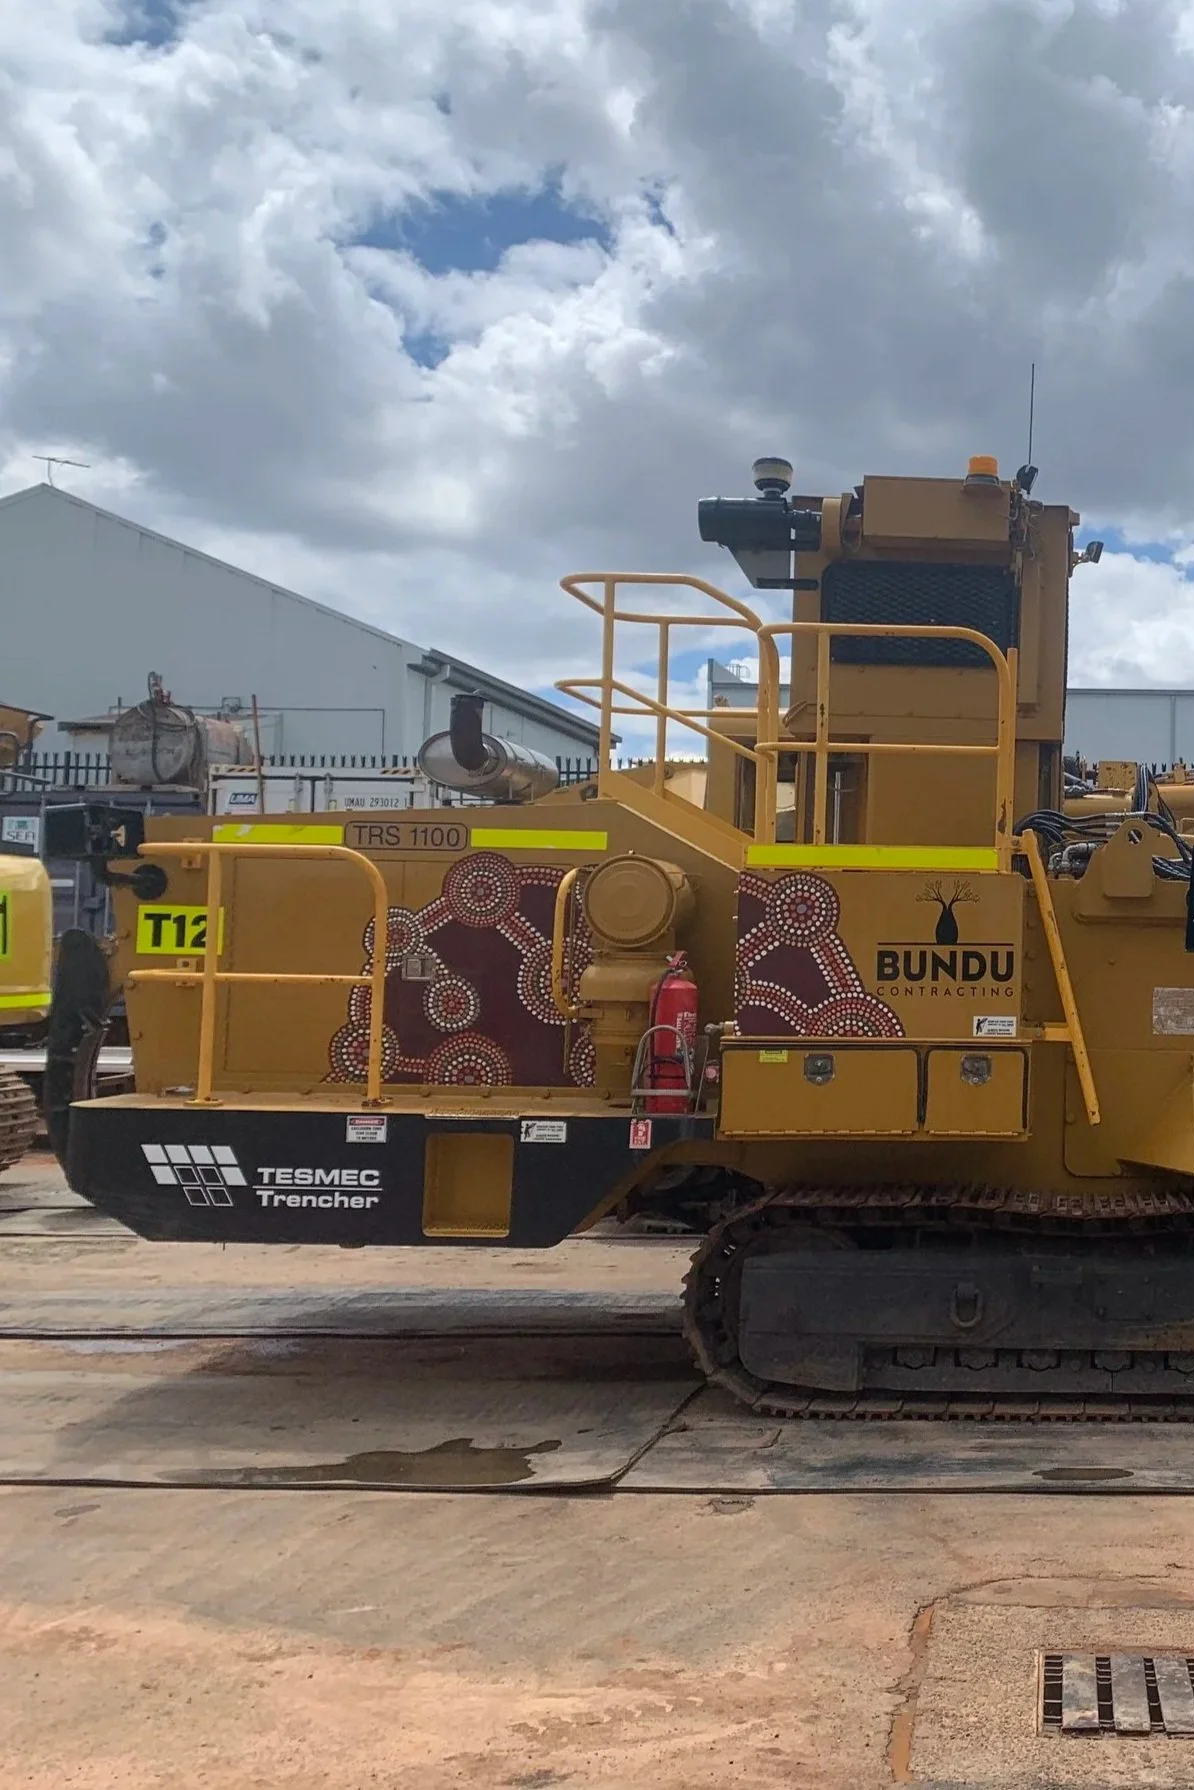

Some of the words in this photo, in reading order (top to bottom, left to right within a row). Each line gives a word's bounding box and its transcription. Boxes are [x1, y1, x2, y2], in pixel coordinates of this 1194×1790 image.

[352, 825, 400, 846] TRS
[410, 827, 460, 847] 1100
[144, 913, 208, 948] T12
[876, 950, 1015, 982] BUNDU
[876, 986, 1015, 998] CONTRACTING
[257, 1167, 380, 1186] TESMEC
[256, 1190, 379, 1208] Trencher
